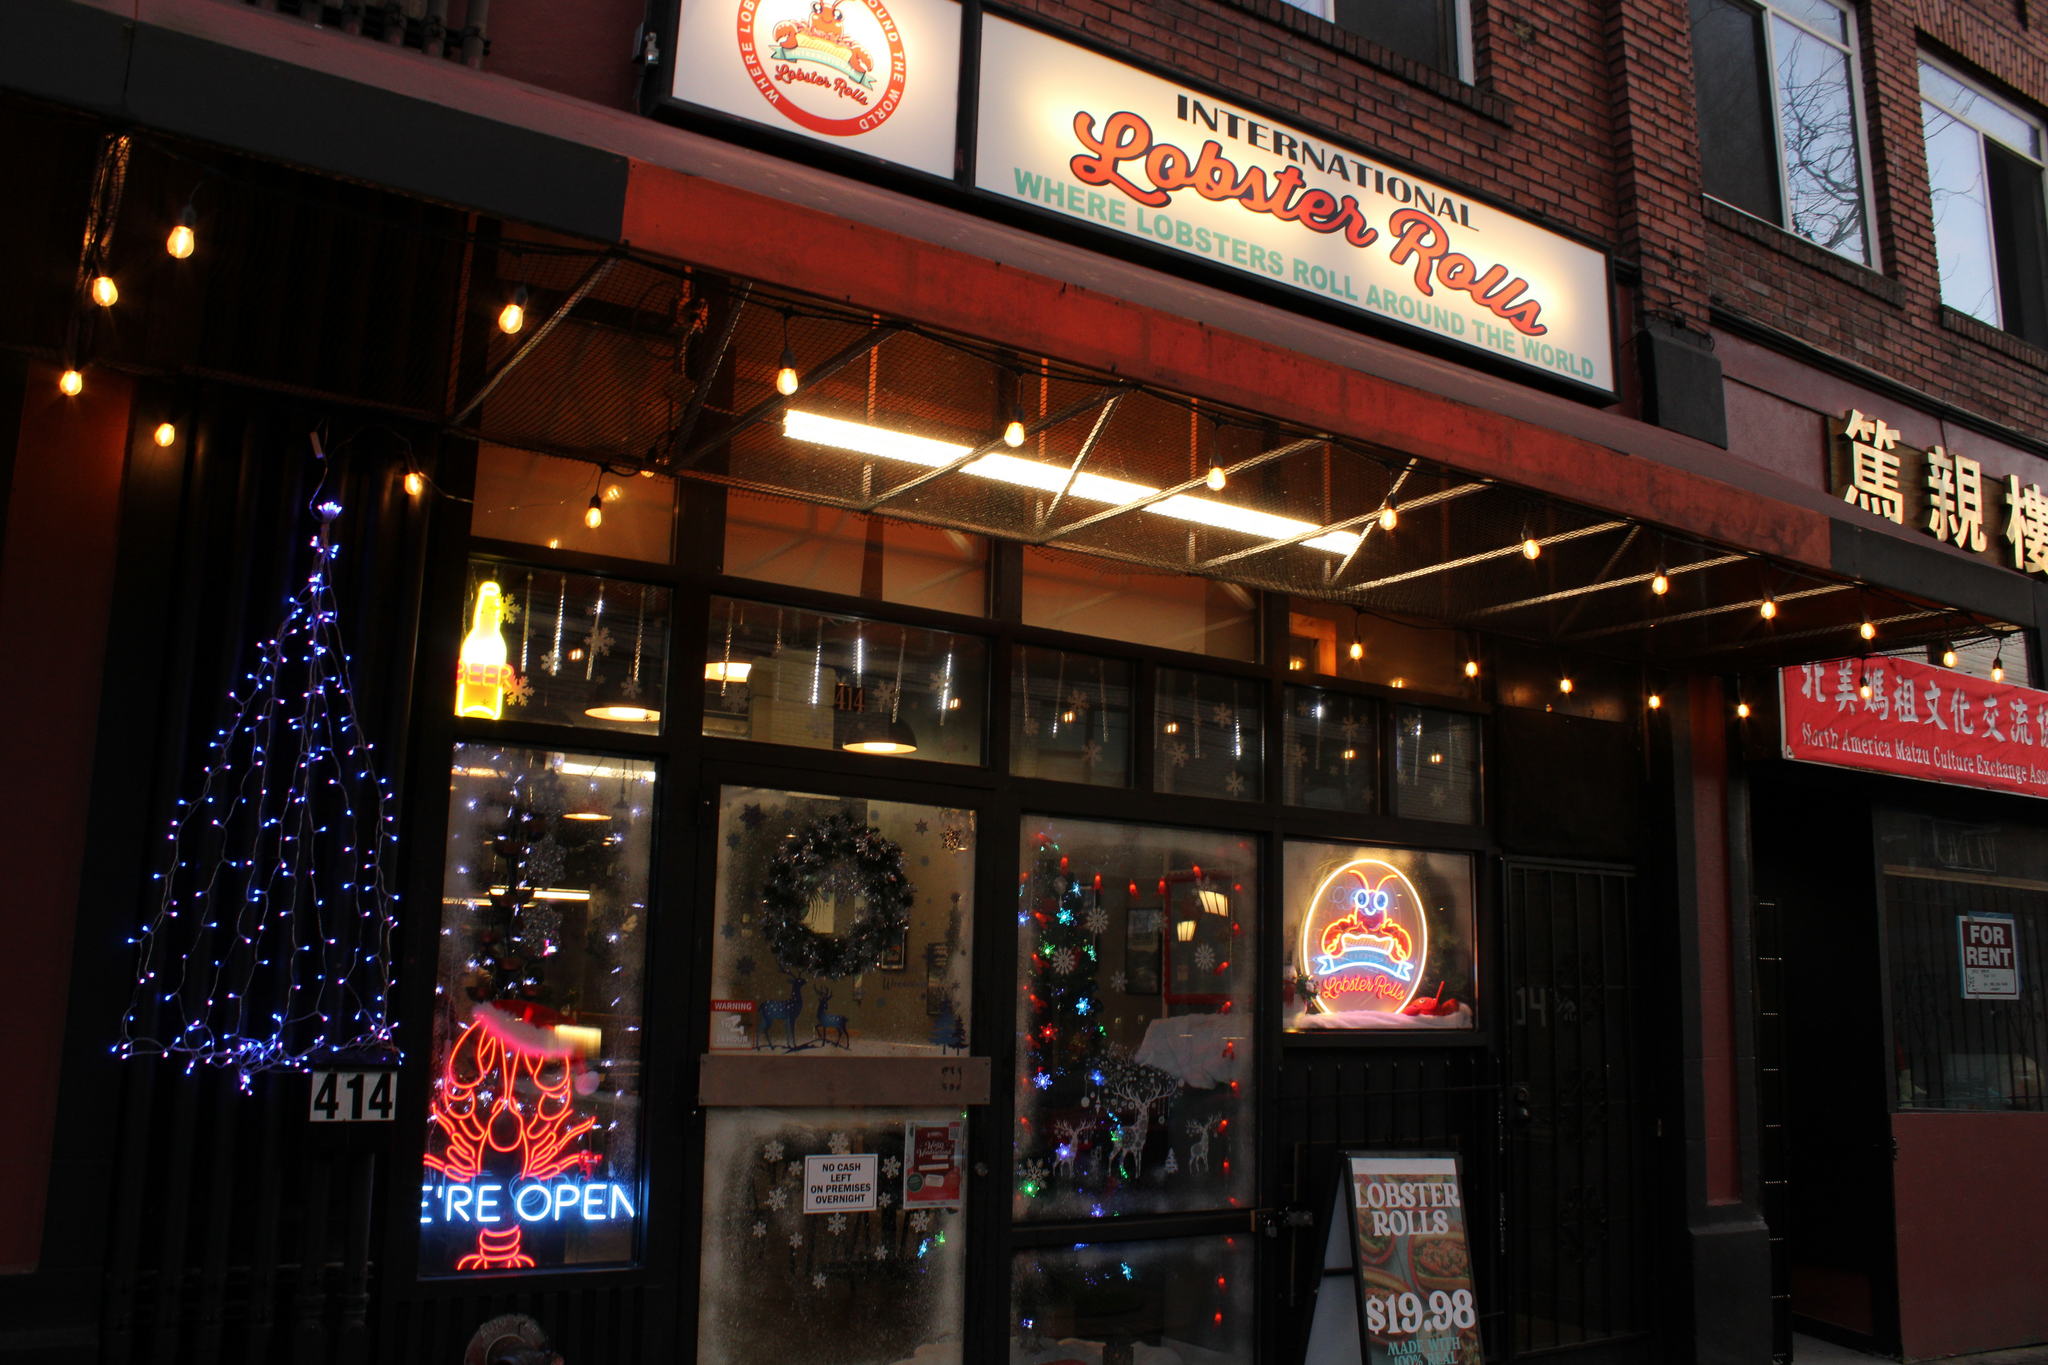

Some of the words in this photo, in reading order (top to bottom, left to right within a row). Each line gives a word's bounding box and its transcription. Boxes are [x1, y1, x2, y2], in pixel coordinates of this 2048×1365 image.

[741, 42, 779, 104] WHERE
[893, 51, 904, 83] THE
[774, 64, 831, 88] Lobster
[833, 77, 868, 105] Rolls
[859, 89, 900, 129] WORLD
[1177, 94, 1480, 232] INTERNATIONAL
[1070, 110, 1378, 248] Lobster
[1389, 208, 1547, 336] Rolls
[1013, 167, 1126, 227] WHERE
[1137, 208, 1284, 276] LOBSTERS
[1293, 257, 1358, 301] ROLL
[1365, 284, 1465, 336] AROUND
[1472, 319, 1516, 354] THE
[1521, 336, 1594, 380] WORLD
[835, 685, 865, 713] 414
[1802, 722, 1838, 749] North
[1842, 729, 1892, 758] America
[1895, 738, 1931, 765] Matzu
[1933, 746, 1974, 773] Culture
[1976, 754, 2027, 784] Exchange
[1969, 925, 2005, 945] FOR
[1966, 946, 2012, 967] RENT
[1321, 975, 1374, 999] Lobster
[1374, 973, 1406, 1000] Rolls
[714, 1002, 752, 1010] WARNING
[726, 1035, 748, 1043] HOUR
[314, 1072, 394, 1120] 414
[822, 1163, 835, 1172] NO
[837, 1162, 861, 1172] CASH
[830, 1173, 852, 1183] LEFT
[810, 1184, 823, 1194] ON
[825, 1182, 871, 1193] PREMISES
[815, 1193, 866, 1204] OVERNIGHT
[1353, 1182, 1461, 1208] LOBSTER
[516, 1183, 635, 1222] OPEN
[1371, 1209, 1449, 1236] ROLLS
[1366, 1289, 1476, 1334] $19.98
[1387, 1340, 1425, 1356] MADE
[1427, 1336, 1462, 1352] WITH
[1393, 1353, 1424, 1365] 100%
[1427, 1351, 1459, 1365] REAL
